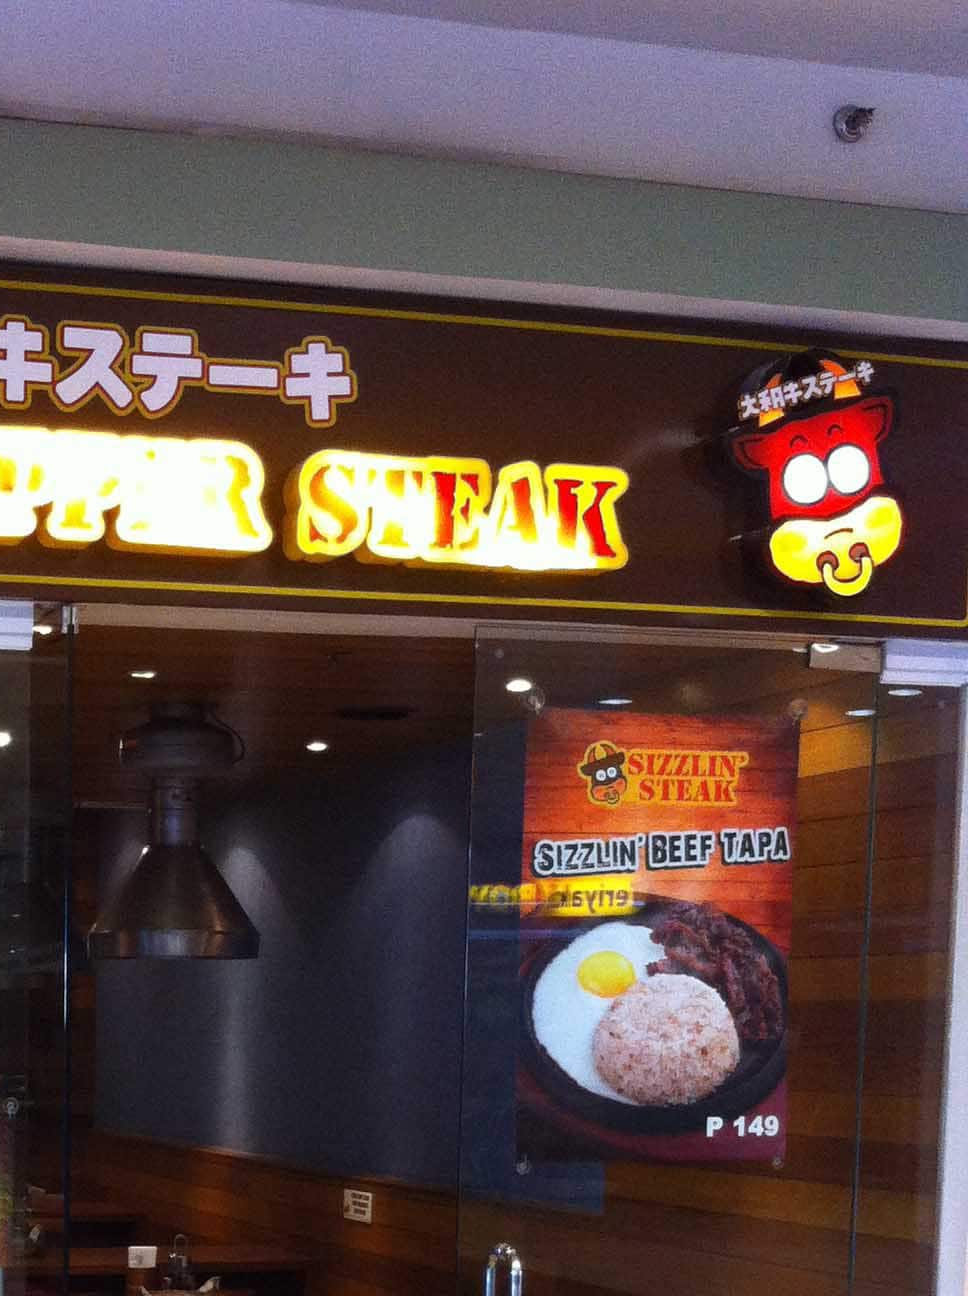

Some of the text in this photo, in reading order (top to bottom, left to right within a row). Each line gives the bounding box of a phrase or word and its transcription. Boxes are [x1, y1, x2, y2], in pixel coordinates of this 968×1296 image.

[302, 458, 624, 566] STEAK
[638, 778, 734, 801] STEAK
[650, 832, 713, 865] BEEF
[722, 829, 790, 861] TAPA
[706, 1115, 780, 1138] P 149
